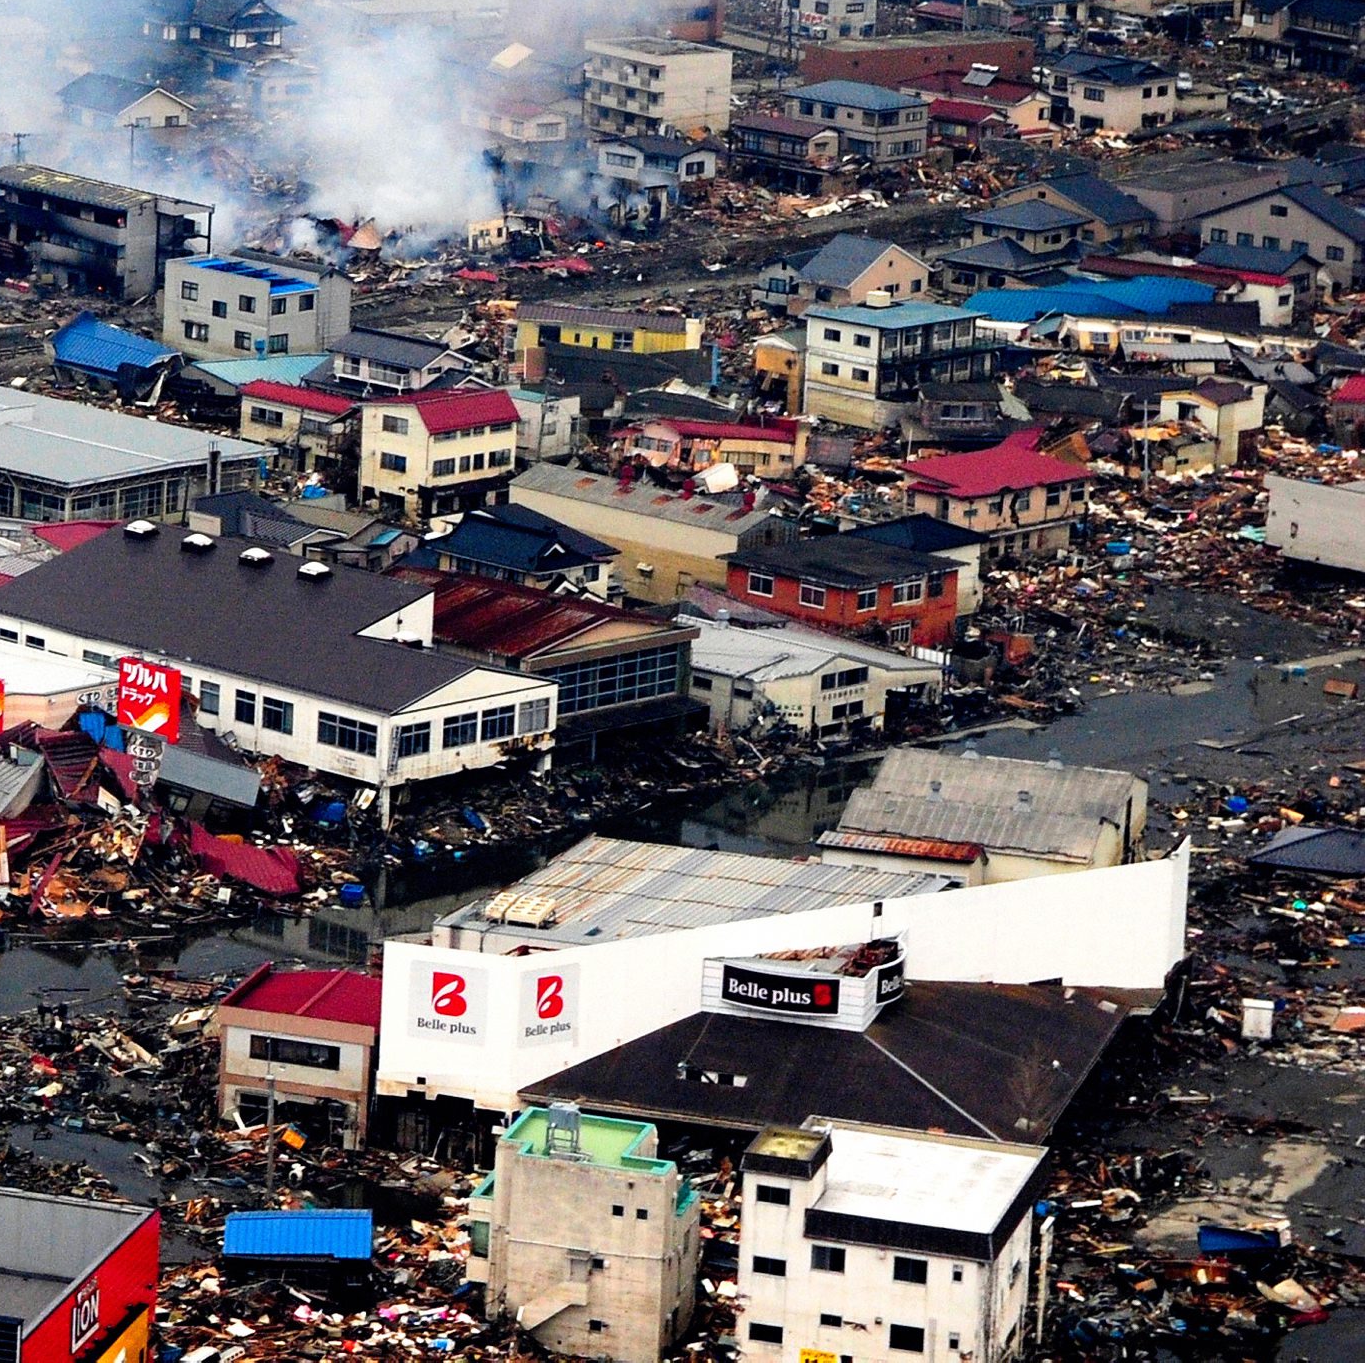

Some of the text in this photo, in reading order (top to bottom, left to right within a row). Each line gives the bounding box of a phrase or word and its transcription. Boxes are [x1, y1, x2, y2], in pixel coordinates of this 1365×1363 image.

[123, 662, 168, 694] ツルハ
[728, 977, 768, 1000] Belle
[771, 988, 811, 1005] plus
[417, 1017, 477, 1035] Belle plus
[525, 1021, 572, 1037] Belle plus
